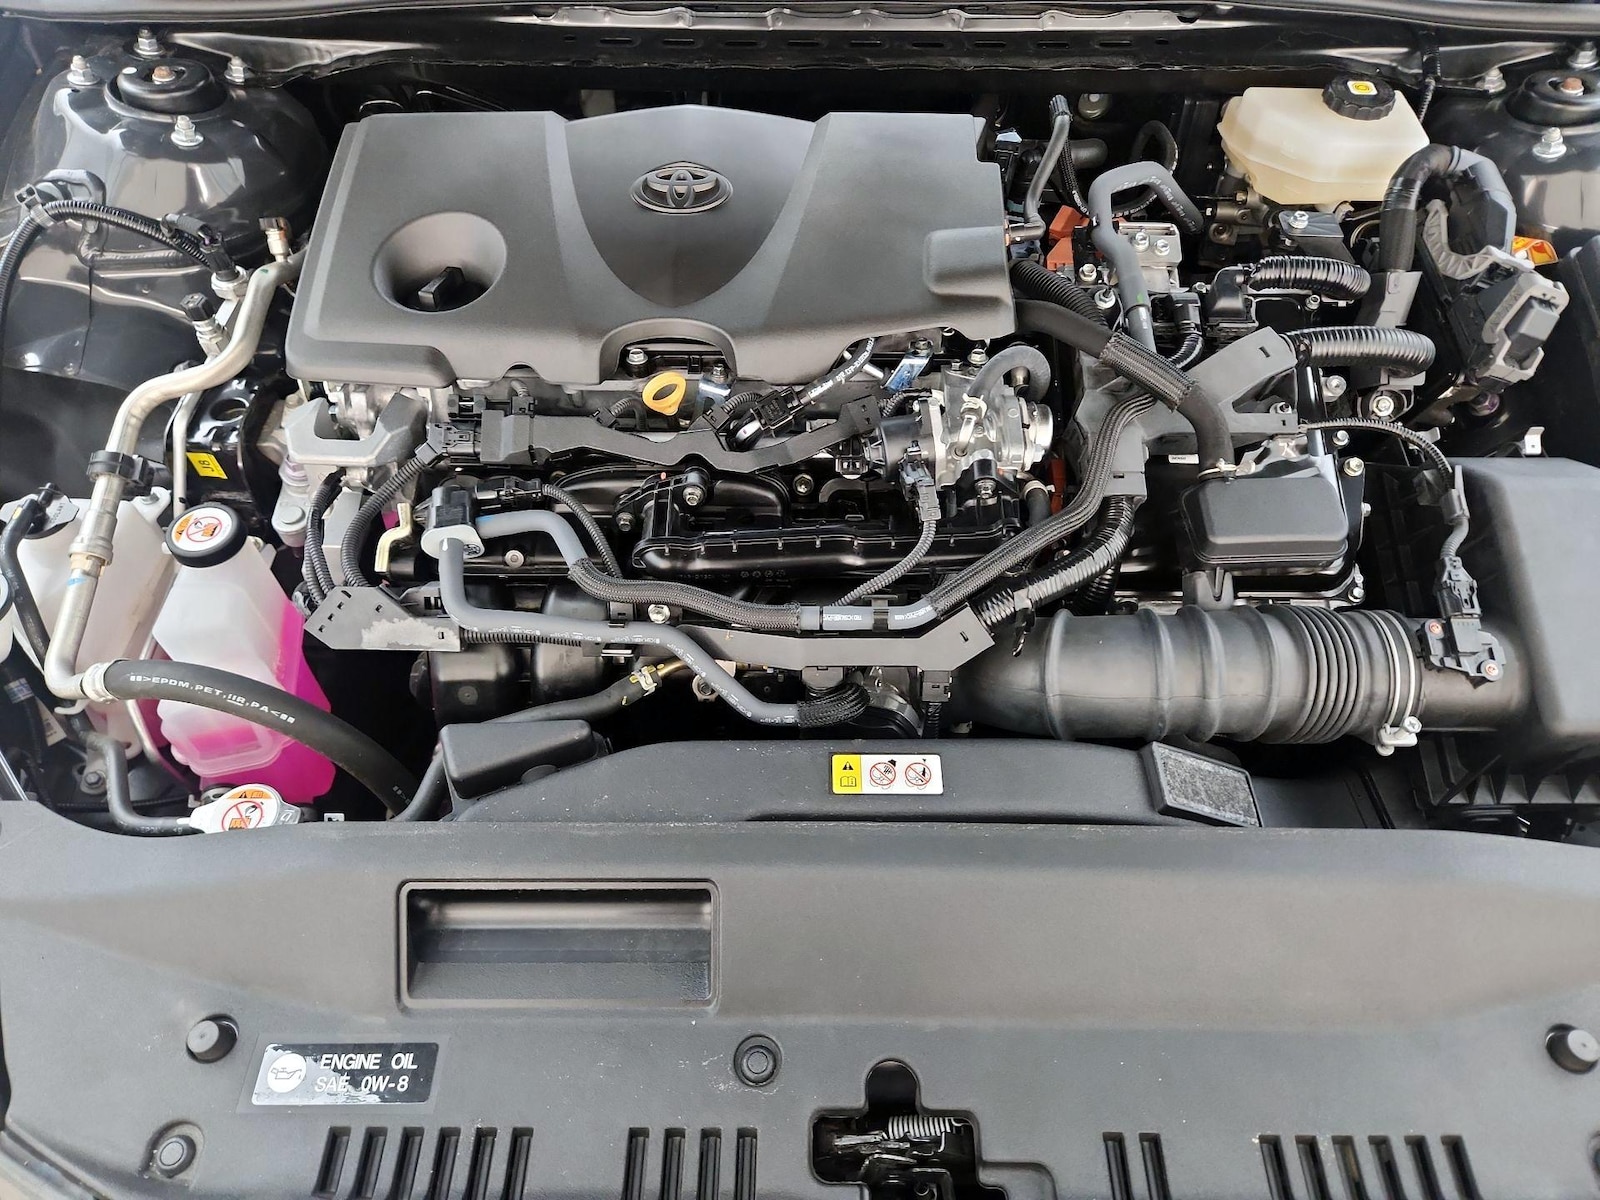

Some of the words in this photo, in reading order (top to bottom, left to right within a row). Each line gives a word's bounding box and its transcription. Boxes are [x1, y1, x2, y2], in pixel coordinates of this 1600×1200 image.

[319, 1053, 382, 1070] ENGINE
[391, 1053, 418, 1070] OIL
[314, 1075, 350, 1092] SAE
